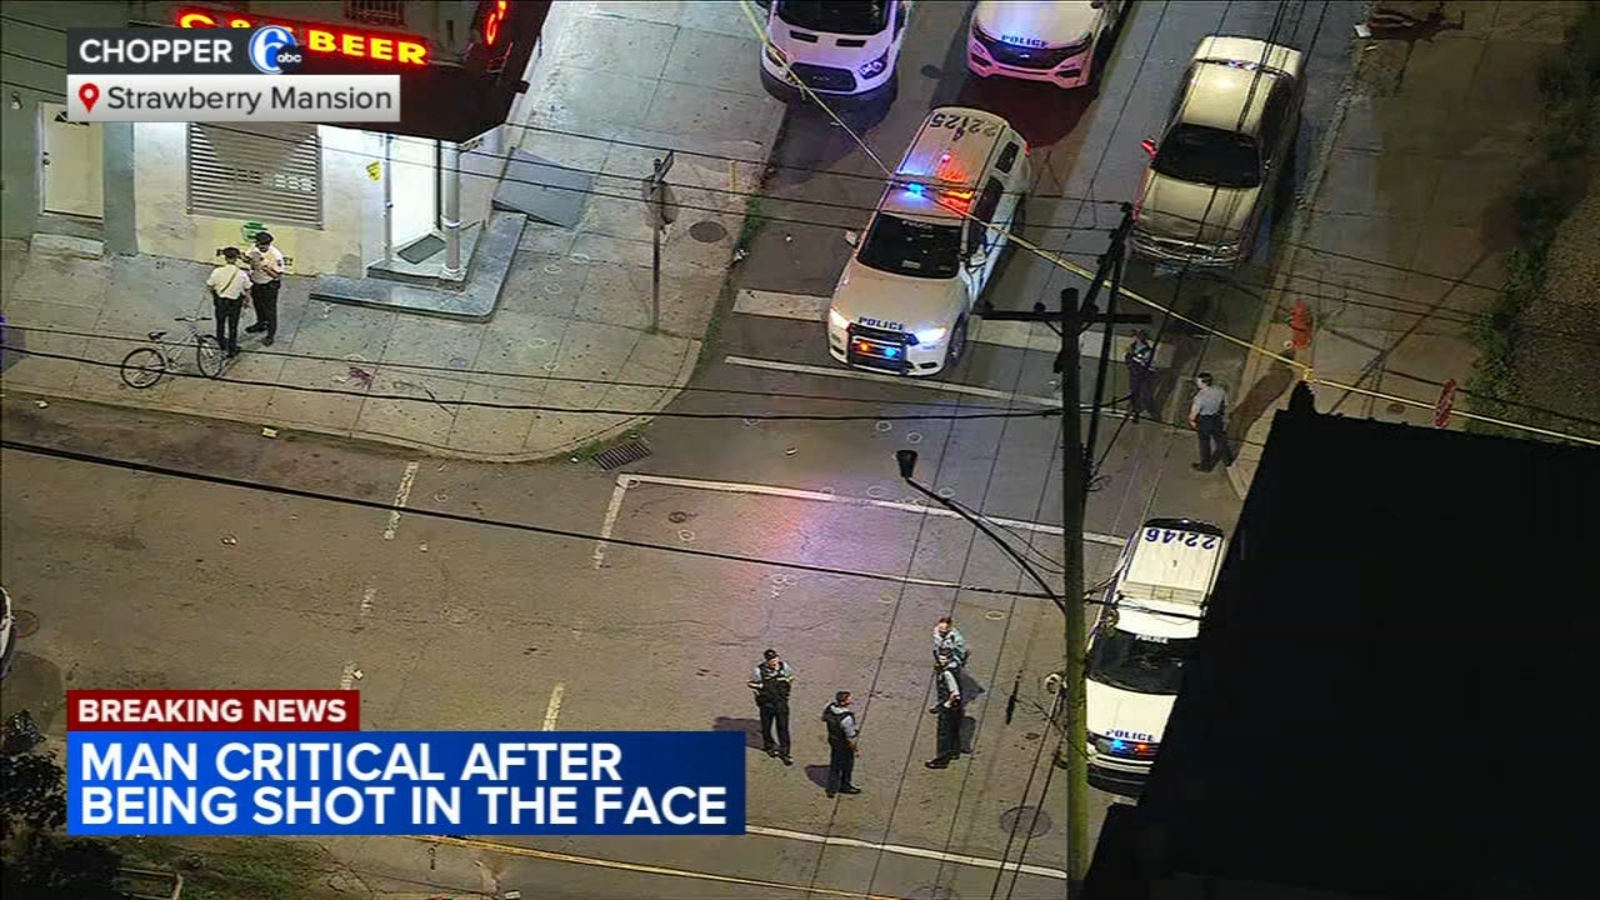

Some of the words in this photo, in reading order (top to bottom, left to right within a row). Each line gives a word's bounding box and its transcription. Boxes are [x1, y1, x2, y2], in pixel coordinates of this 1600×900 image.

[308, 28, 428, 66] BEER
[1001, 34, 1049, 49] POLICE
[858, 316, 906, 331] POLICE
[1145, 528, 1217, 550] 22146
[1105, 729, 1155, 742] POLICE
